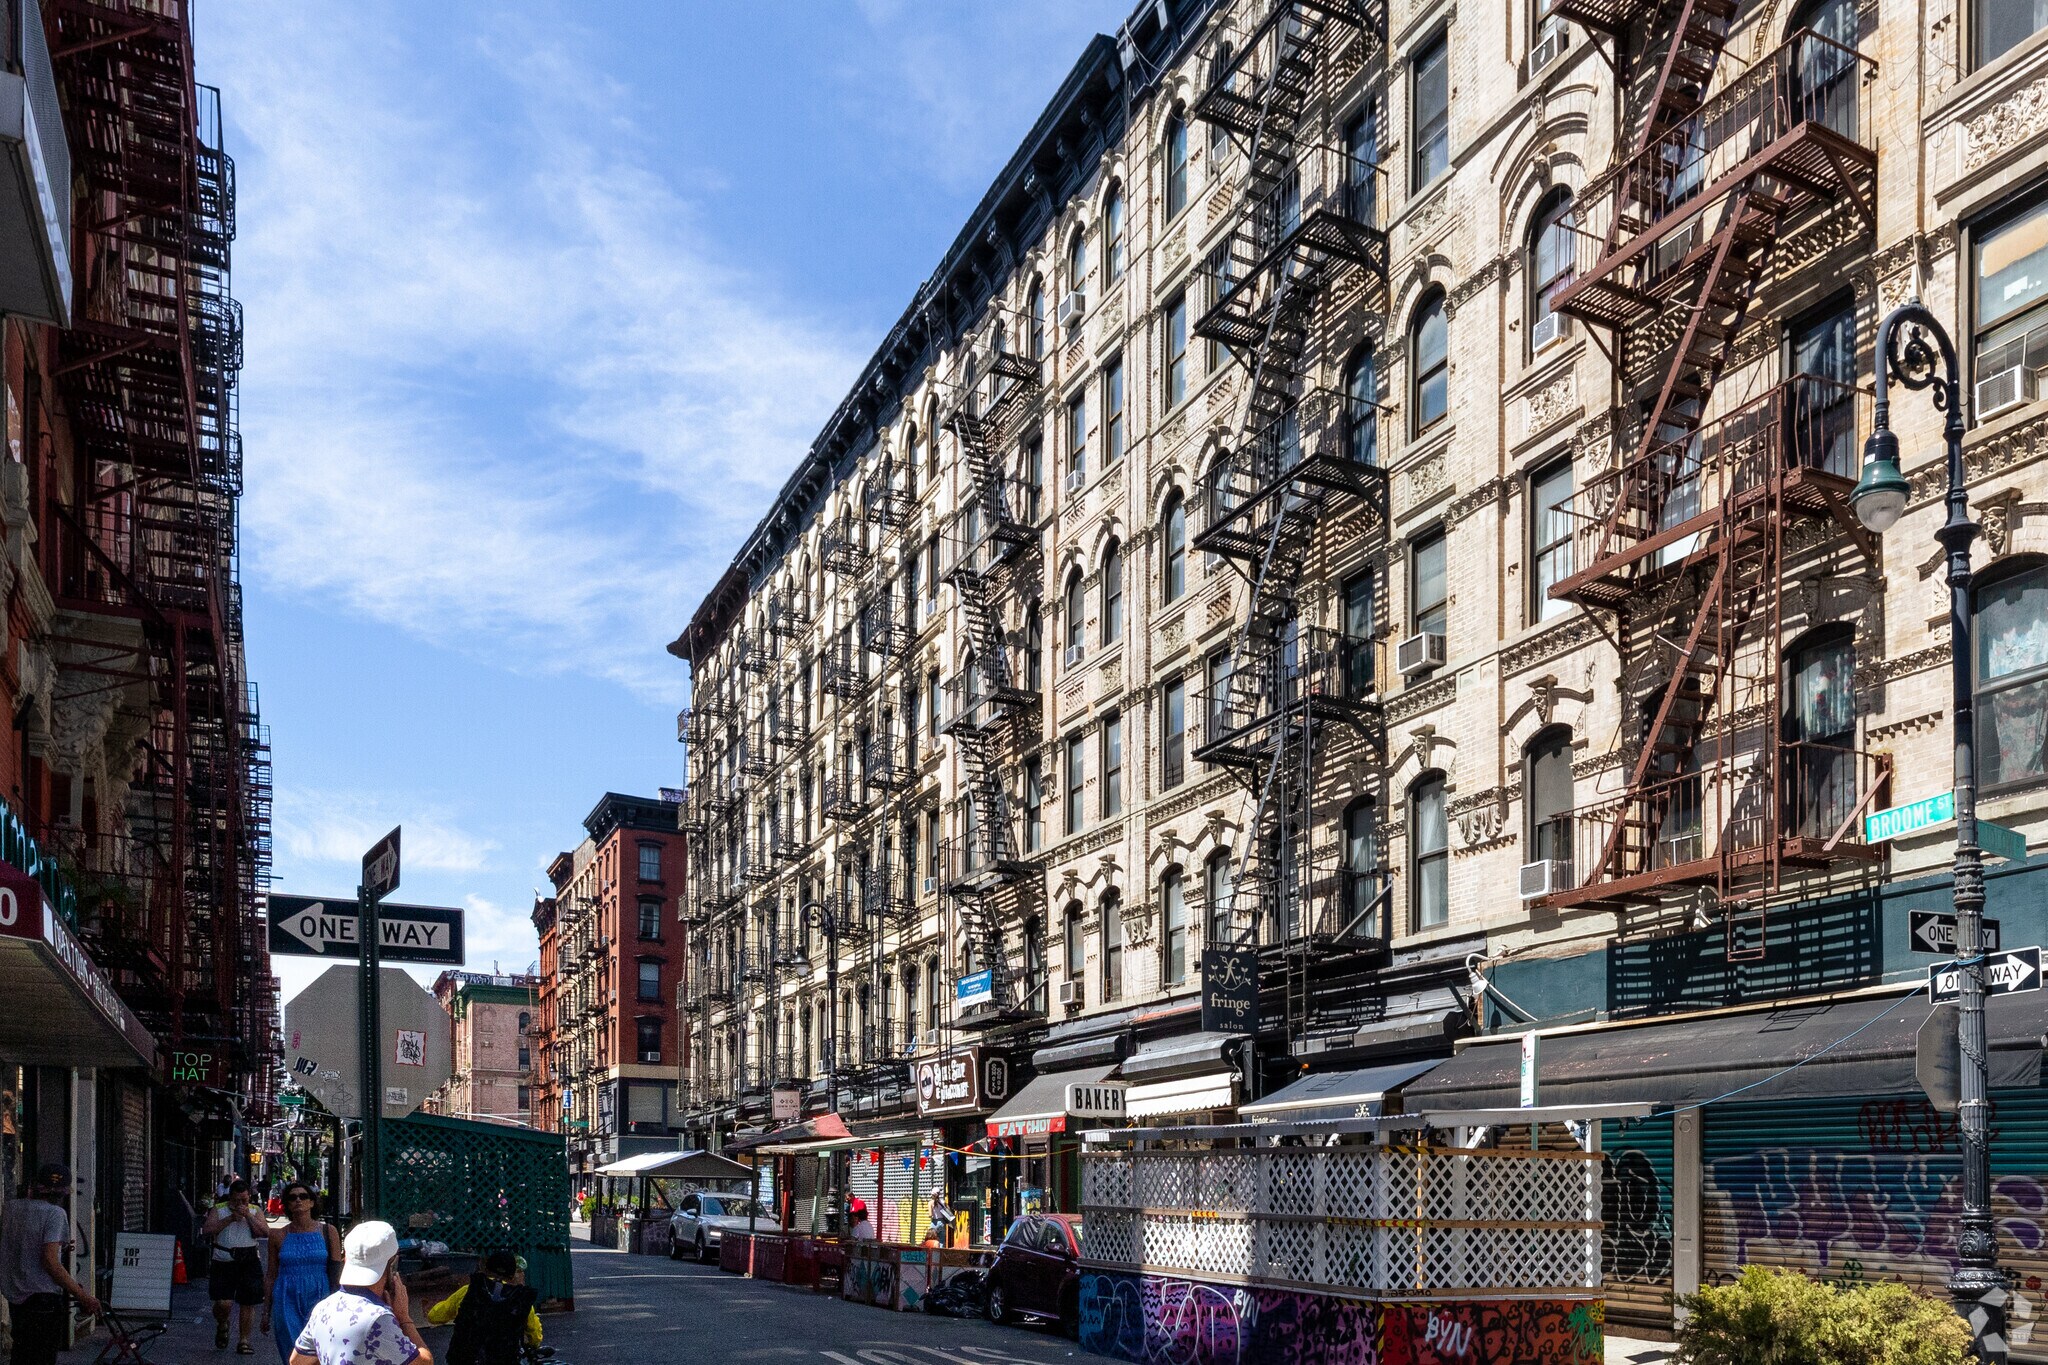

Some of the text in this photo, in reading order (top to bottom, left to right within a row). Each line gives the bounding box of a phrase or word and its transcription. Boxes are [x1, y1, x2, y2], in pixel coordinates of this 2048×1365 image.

[1870, 796, 1950, 839] BROOME ST
[300, 915, 438, 946] ONE WAY
[1928, 925, 1953, 942] ONE
[1990, 963, 2022, 983] WAY
[1211, 992, 1251, 1017] fringe
[1220, 1021, 1244, 1030] salon
[172, 1051, 212, 1067] TOP
[173, 1067, 210, 1081] HAT
[1075, 1087, 1126, 1111] BAKERY
[998, 1120, 1027, 1136] FAT
[1026, 1118, 1051, 1134] CHOY
[122, 1257, 140, 1267] HAT
[124, 1248, 140, 1257] TOP
[1233, 1289, 1261, 1328] BYN
[1425, 1310, 1472, 1357] BYN
